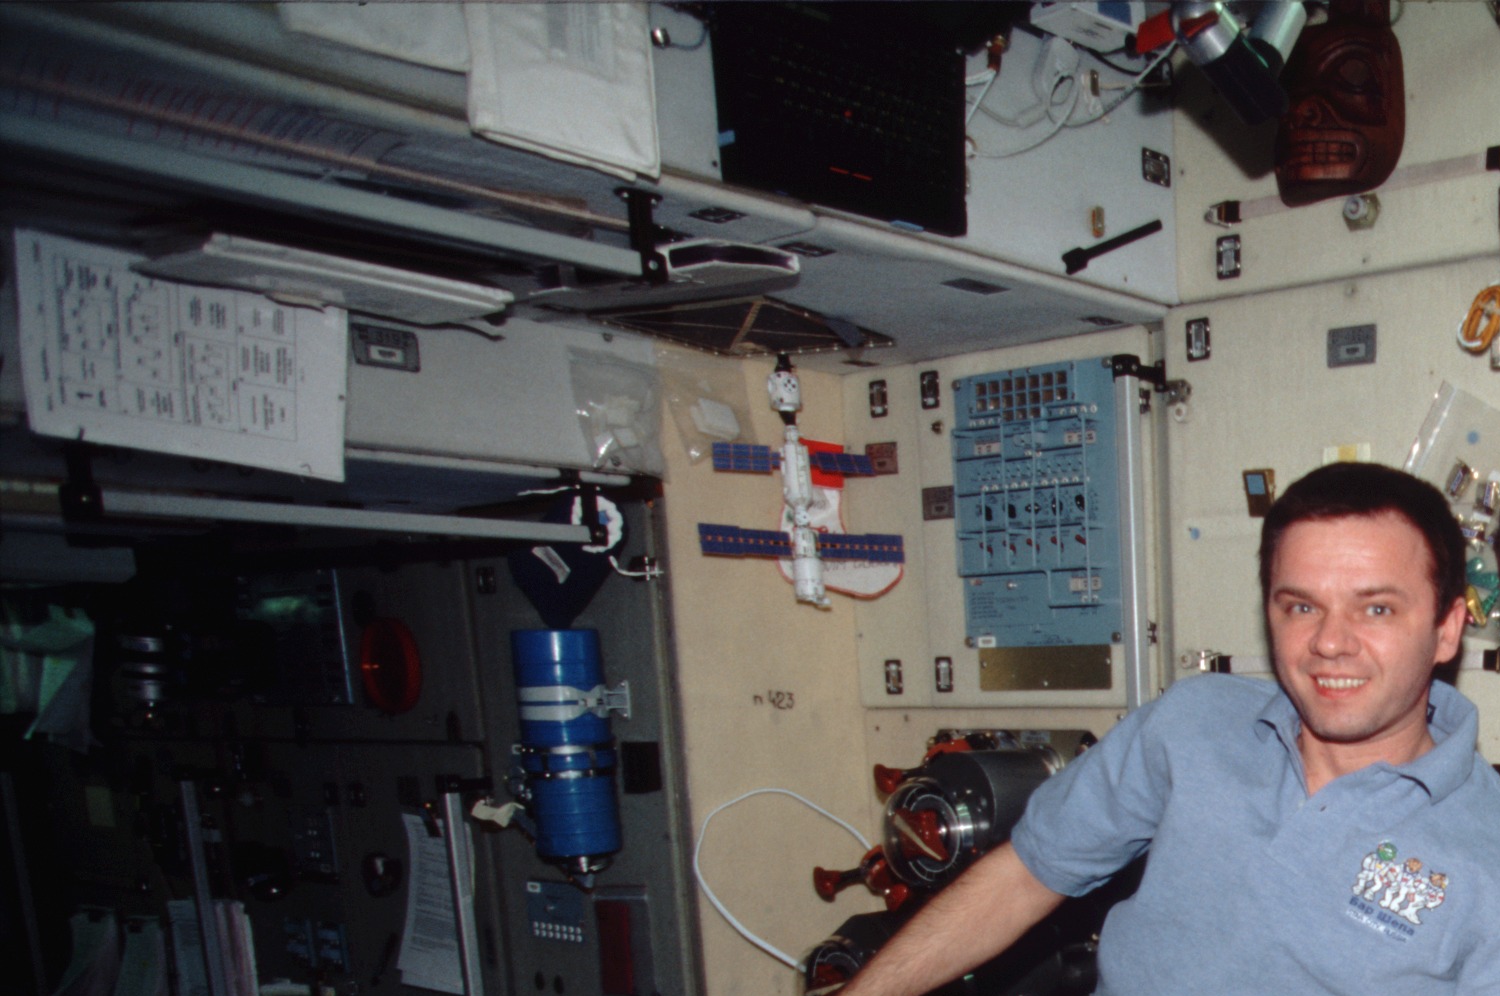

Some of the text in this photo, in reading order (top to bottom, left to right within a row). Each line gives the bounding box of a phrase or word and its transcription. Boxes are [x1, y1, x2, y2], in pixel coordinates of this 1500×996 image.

[768, 689, 796, 710] 423
[1349, 896, 1374, 915] Бар
[1376, 911, 1415, 936] Шепа
